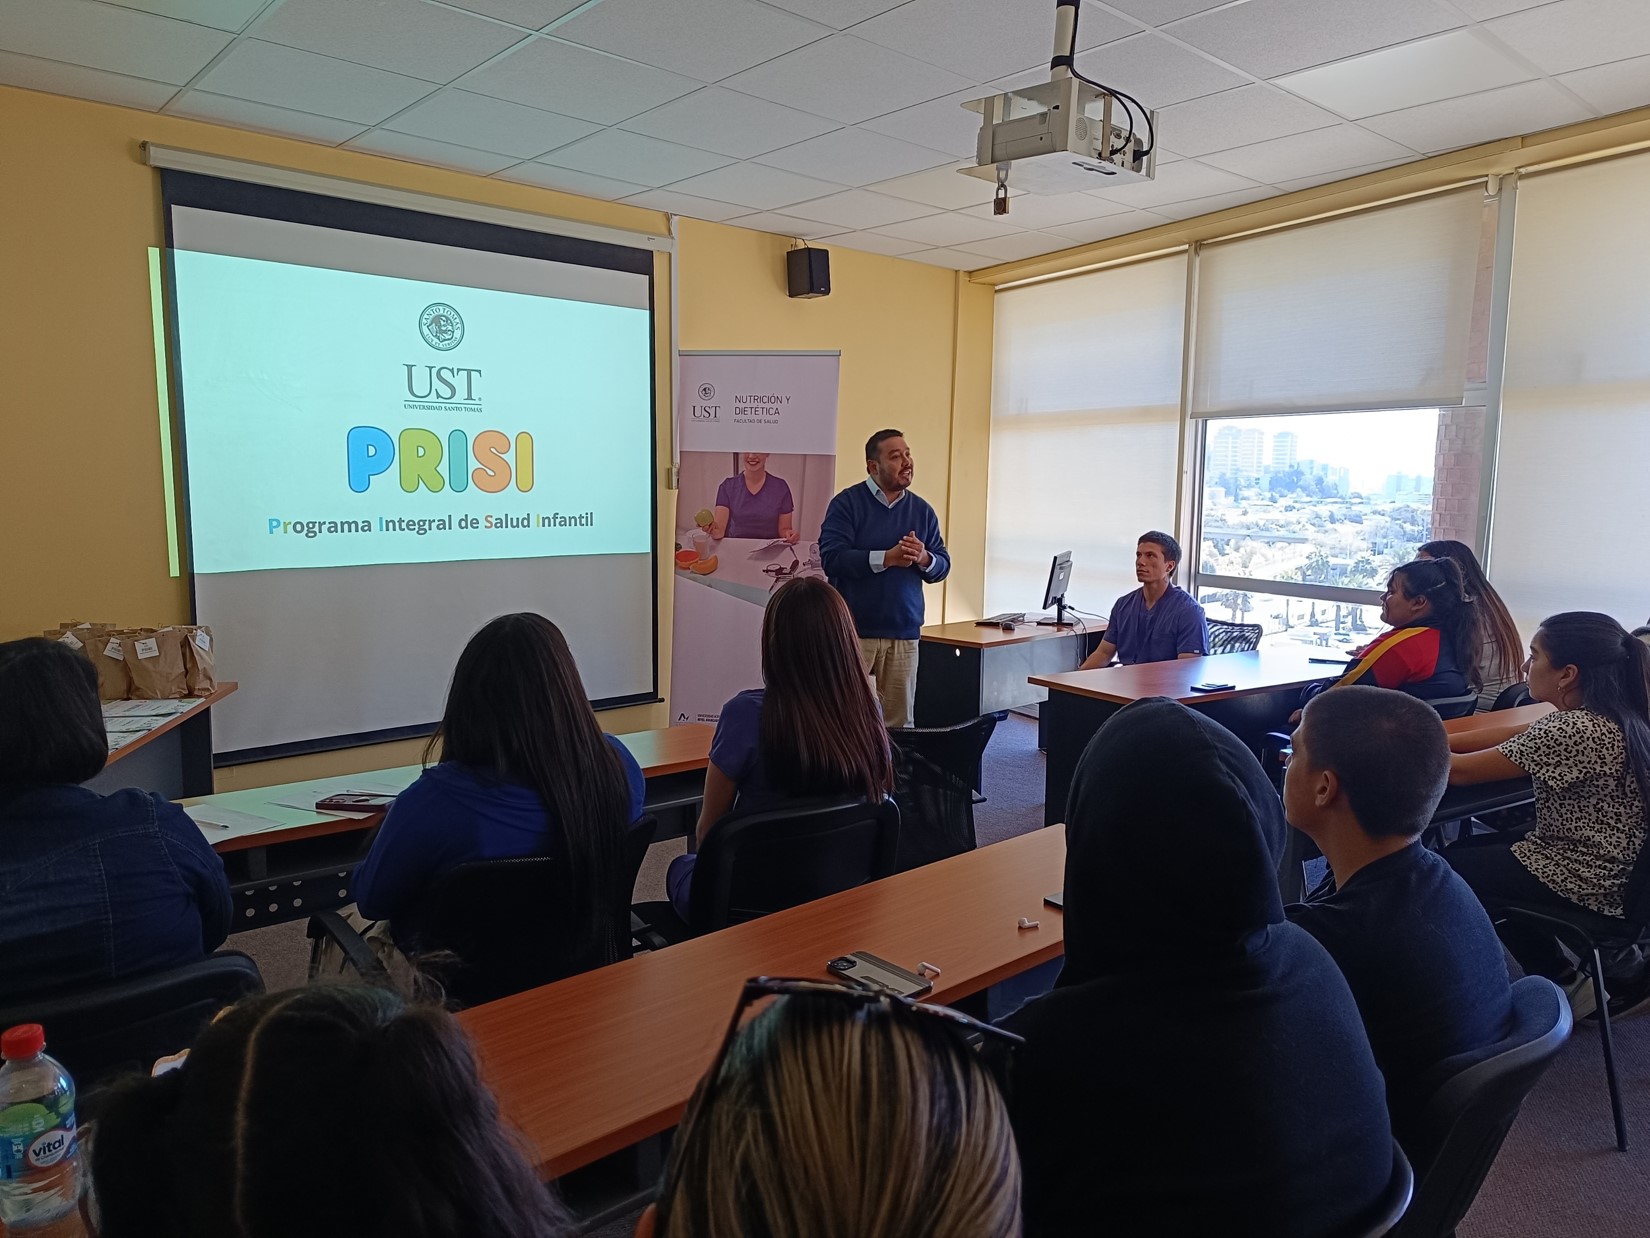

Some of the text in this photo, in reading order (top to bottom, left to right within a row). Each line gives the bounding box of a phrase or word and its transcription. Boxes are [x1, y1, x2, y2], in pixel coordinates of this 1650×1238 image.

[422, 307, 441, 327] SANTO
[402, 363, 482, 401] UST
[403, 403, 443, 412] UNIVERSIDAD
[443, 405, 463, 413] SANTO
[734, 393, 792, 404] NUTRICIÓN Y
[692, 405, 721, 419] UST
[734, 404, 781, 416] DIETÉTICA
[346, 425, 534, 494] PRISI
[268, 511, 594, 539] Programa Integral de Salud Infantil
[32, 1134, 65, 1157] vital
